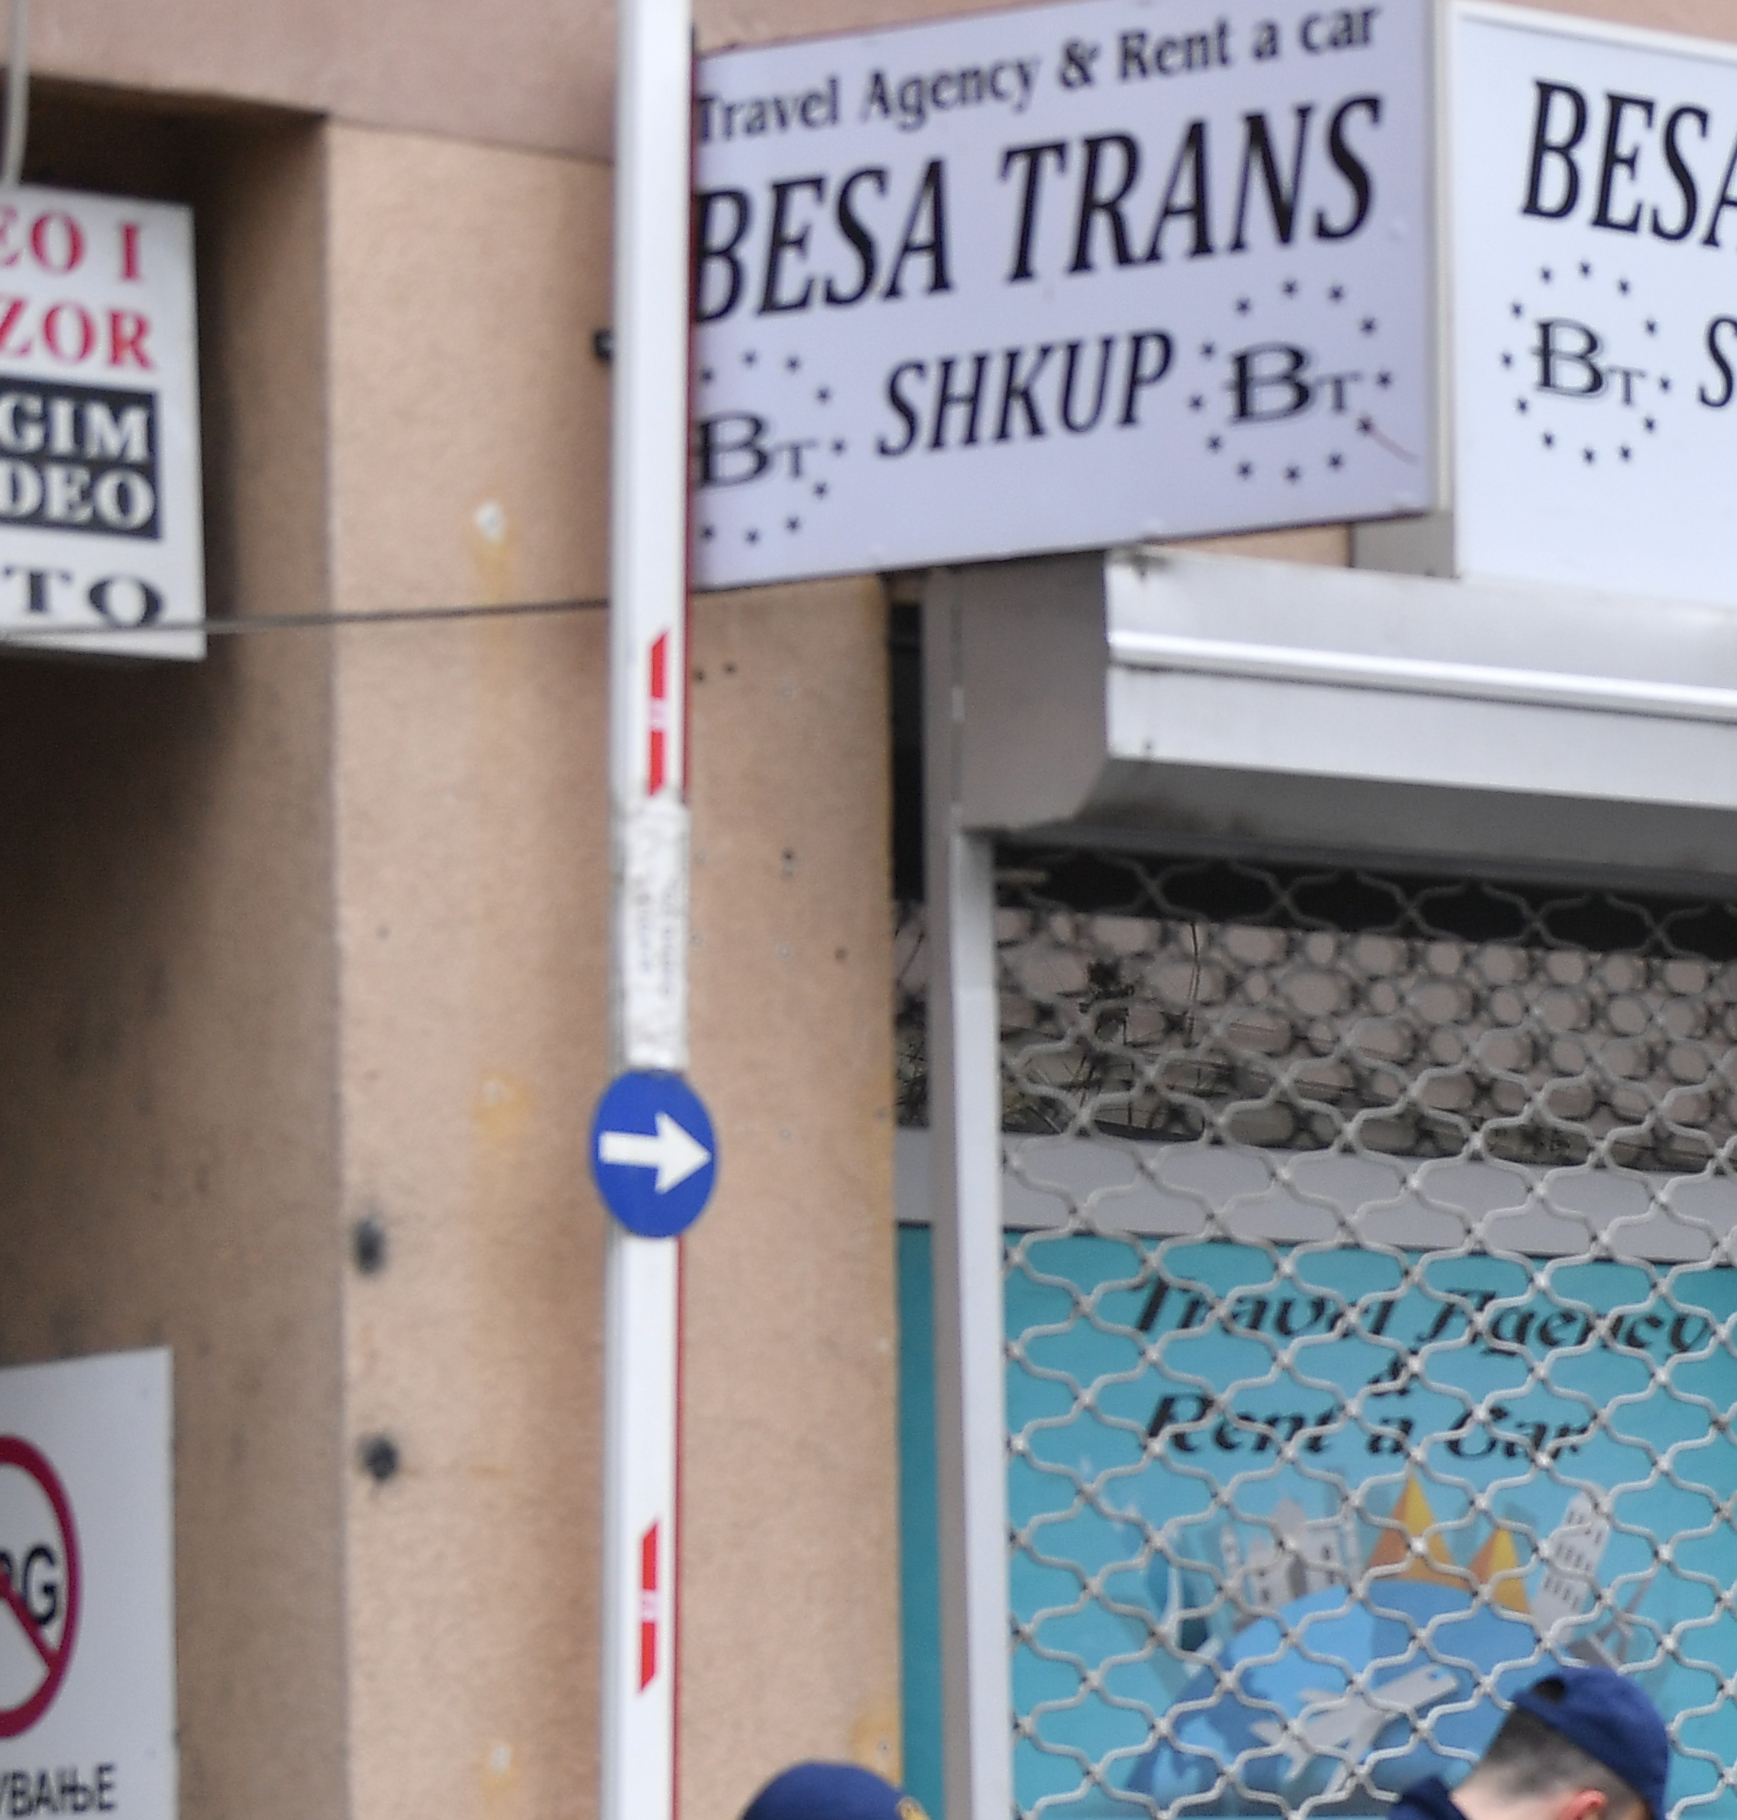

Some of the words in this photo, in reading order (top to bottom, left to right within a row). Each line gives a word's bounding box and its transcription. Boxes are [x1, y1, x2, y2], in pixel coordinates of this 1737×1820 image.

[698, 78, 839, 142] Travel
[861, 56, 1037, 130] Agency
[1056, 40, 1102, 90] &
[1117, 17, 1231, 82] Rent
[1253, 27, 1279, 60] a
[1299, 3, 1382, 53] car
[693, 158, 956, 325] BESA
[998, 95, 1384, 286] TRANS
[876, 329, 1175, 460] SHKUP
